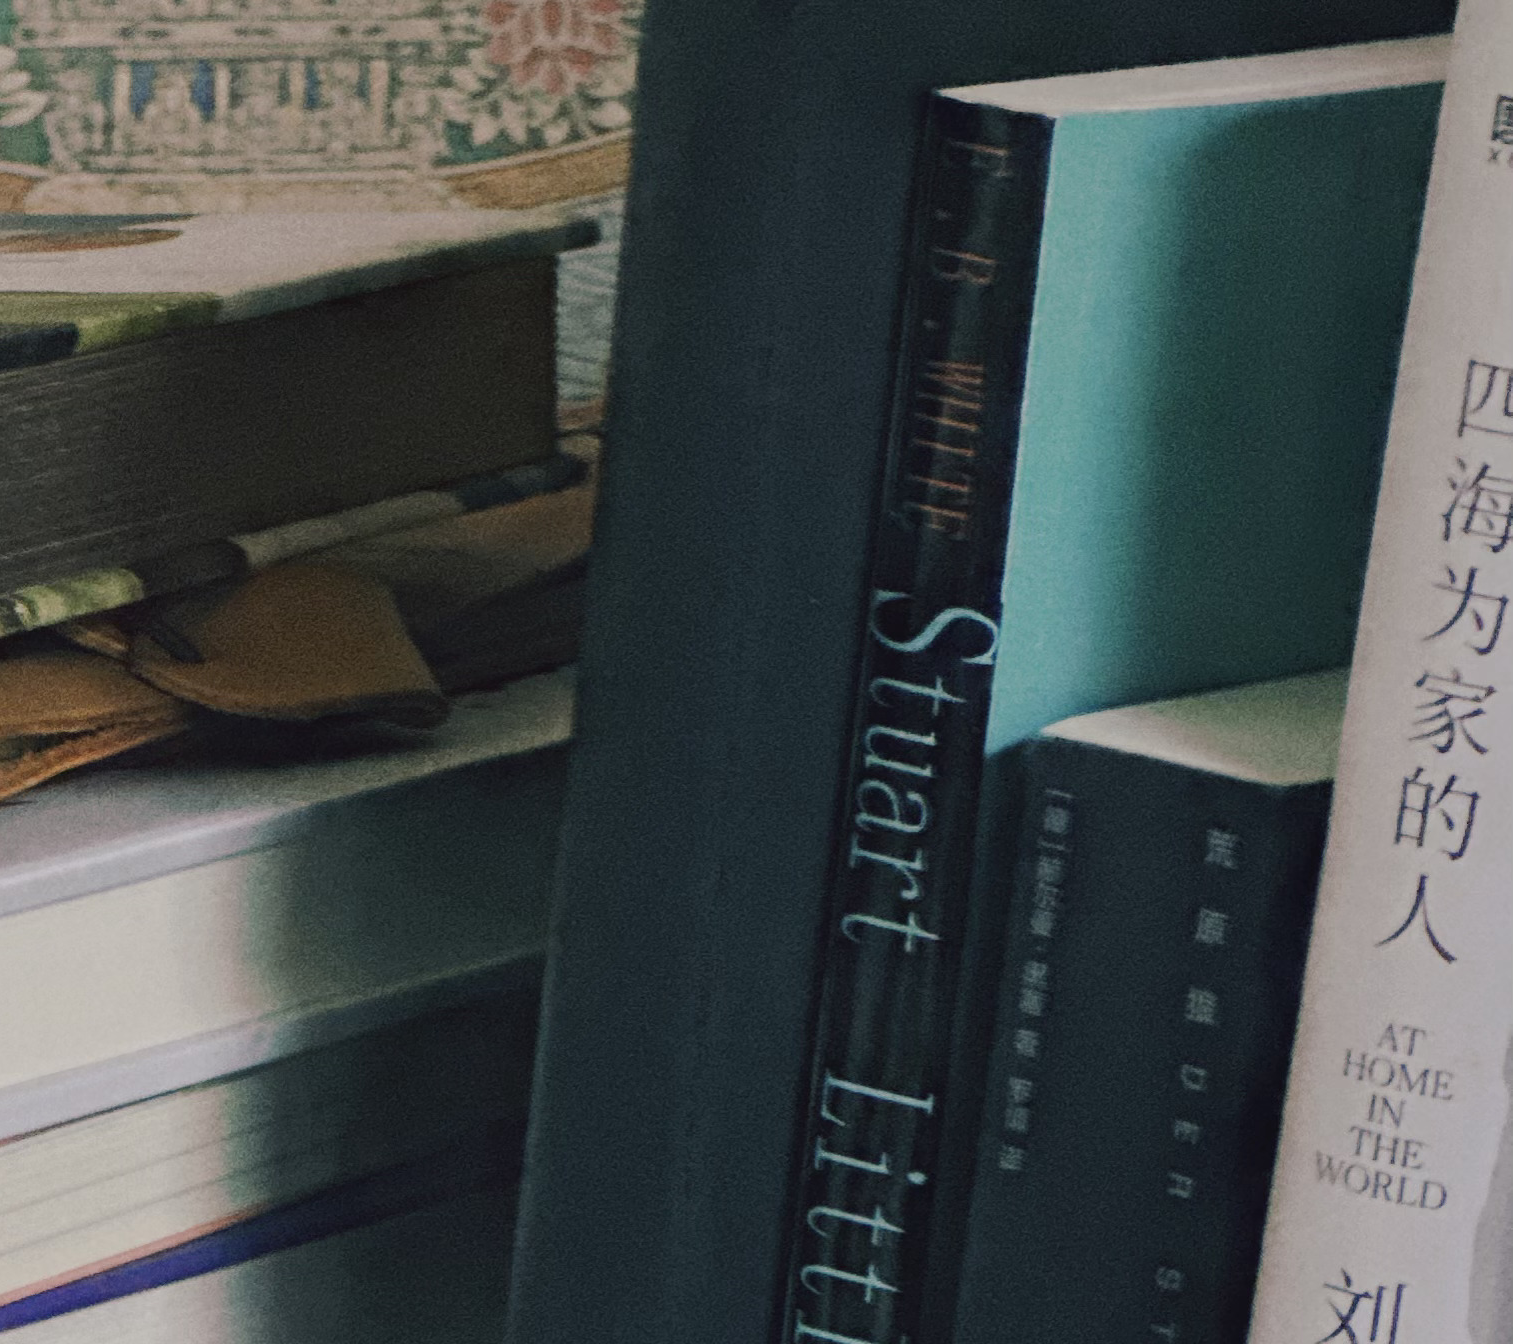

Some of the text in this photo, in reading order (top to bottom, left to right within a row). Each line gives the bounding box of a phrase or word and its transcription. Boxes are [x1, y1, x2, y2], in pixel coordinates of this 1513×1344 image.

[1375, 360, 1513, 964] 四海为家的人
[840, 588, 1000, 953] Stuart
[1376, 1023, 1427, 1059] AT
[1342, 1049, 1456, 1101] HOME
[1367, 1094, 1407, 1130] IN
[1348, 1124, 1427, 1171] THE
[1314, 1150, 1449, 1212] WORLD
